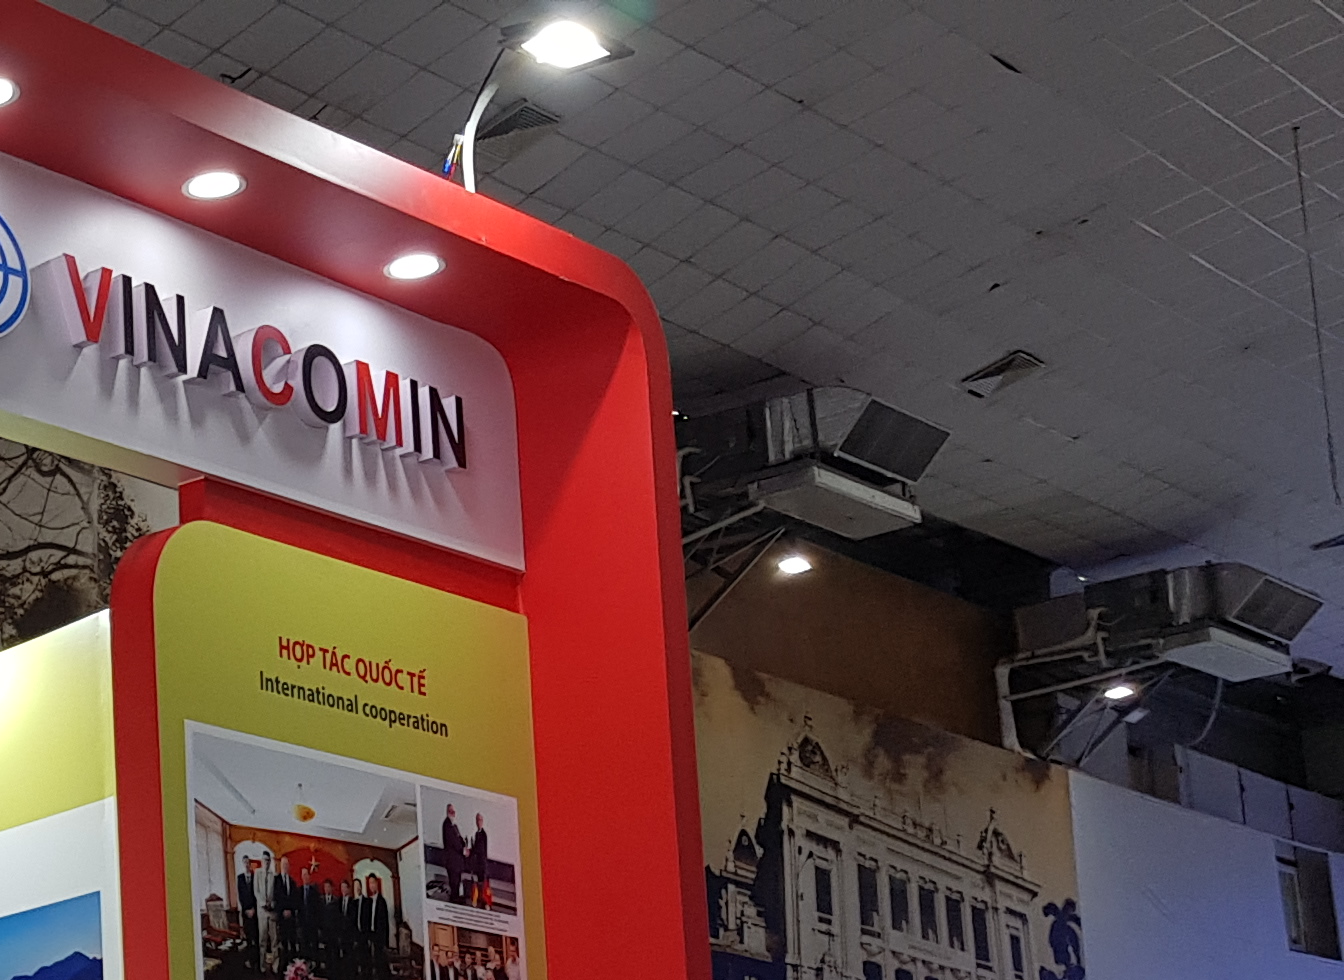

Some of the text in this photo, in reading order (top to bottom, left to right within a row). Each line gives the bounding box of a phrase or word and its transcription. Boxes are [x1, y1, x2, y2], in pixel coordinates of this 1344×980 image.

[61, 252, 468, 471] VINACOMIN
[278, 636, 427, 696] HỢP TÁC QUỐC TẾ
[259, 670, 448, 737] International cooperation
